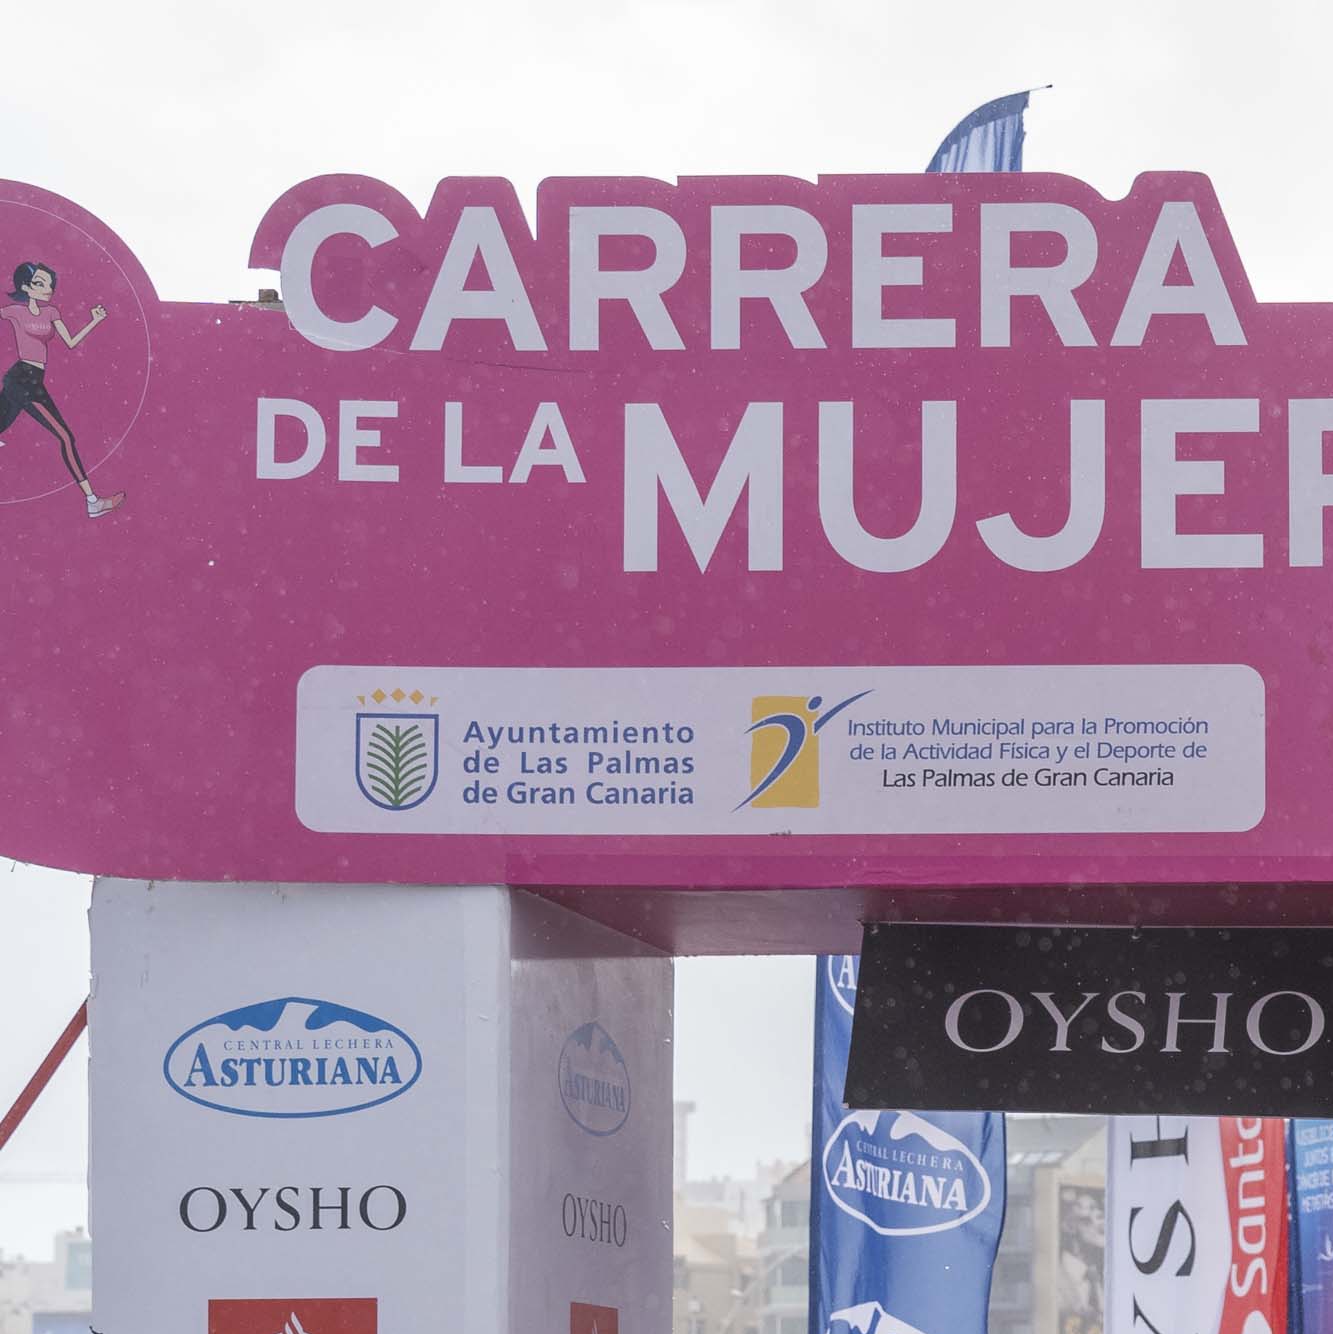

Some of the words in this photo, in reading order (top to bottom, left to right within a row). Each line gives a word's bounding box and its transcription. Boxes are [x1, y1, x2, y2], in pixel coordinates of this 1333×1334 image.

[280, 202, 1248, 352] CARRERA
[257, 397, 399, 482] DE
[444, 402, 586, 483] LA
[463, 721, 693, 749] Ayuntamiento
[849, 719, 925, 736] Instituto
[932, 719, 1024, 740] Municipal
[1032, 722, 1074, 739] para
[1082, 718, 1096, 734] la
[1105, 717, 1208, 734] Promoción
[464, 750, 499, 773] de
[521, 752, 567, 774] Las
[589, 750, 694, 773] Palmas
[850, 744, 874, 760] de
[882, 744, 896, 760] la
[903, 743, 992, 759] Actividad
[1000, 743, 1049, 759] Física
[1056, 746, 1068, 763] y
[1074, 742, 1090, 758] el
[1098, 742, 1176, 763] Deporte
[1183, 742, 1207, 758] de
[883, 769, 915, 787] Las
[923, 769, 995, 787] Palmas
[1002, 769, 1028, 786] de
[1035, 768, 1086, 786] Gran
[1094, 768, 1173, 786] Canaria
[463, 780, 497, 803] de
[507, 782, 574, 804] Gran
[586, 781, 693, 804] Canaria
[945, 990, 1324, 1055] OYSHO
[224, 1040, 303, 1051] CENTRAL
[313, 1039, 392, 1049] LECHERA
[184, 1039, 402, 1087] ASTURIANA
[180, 1185, 406, 1232] OYSHO
[562, 1193, 626, 1247] OYSHO
